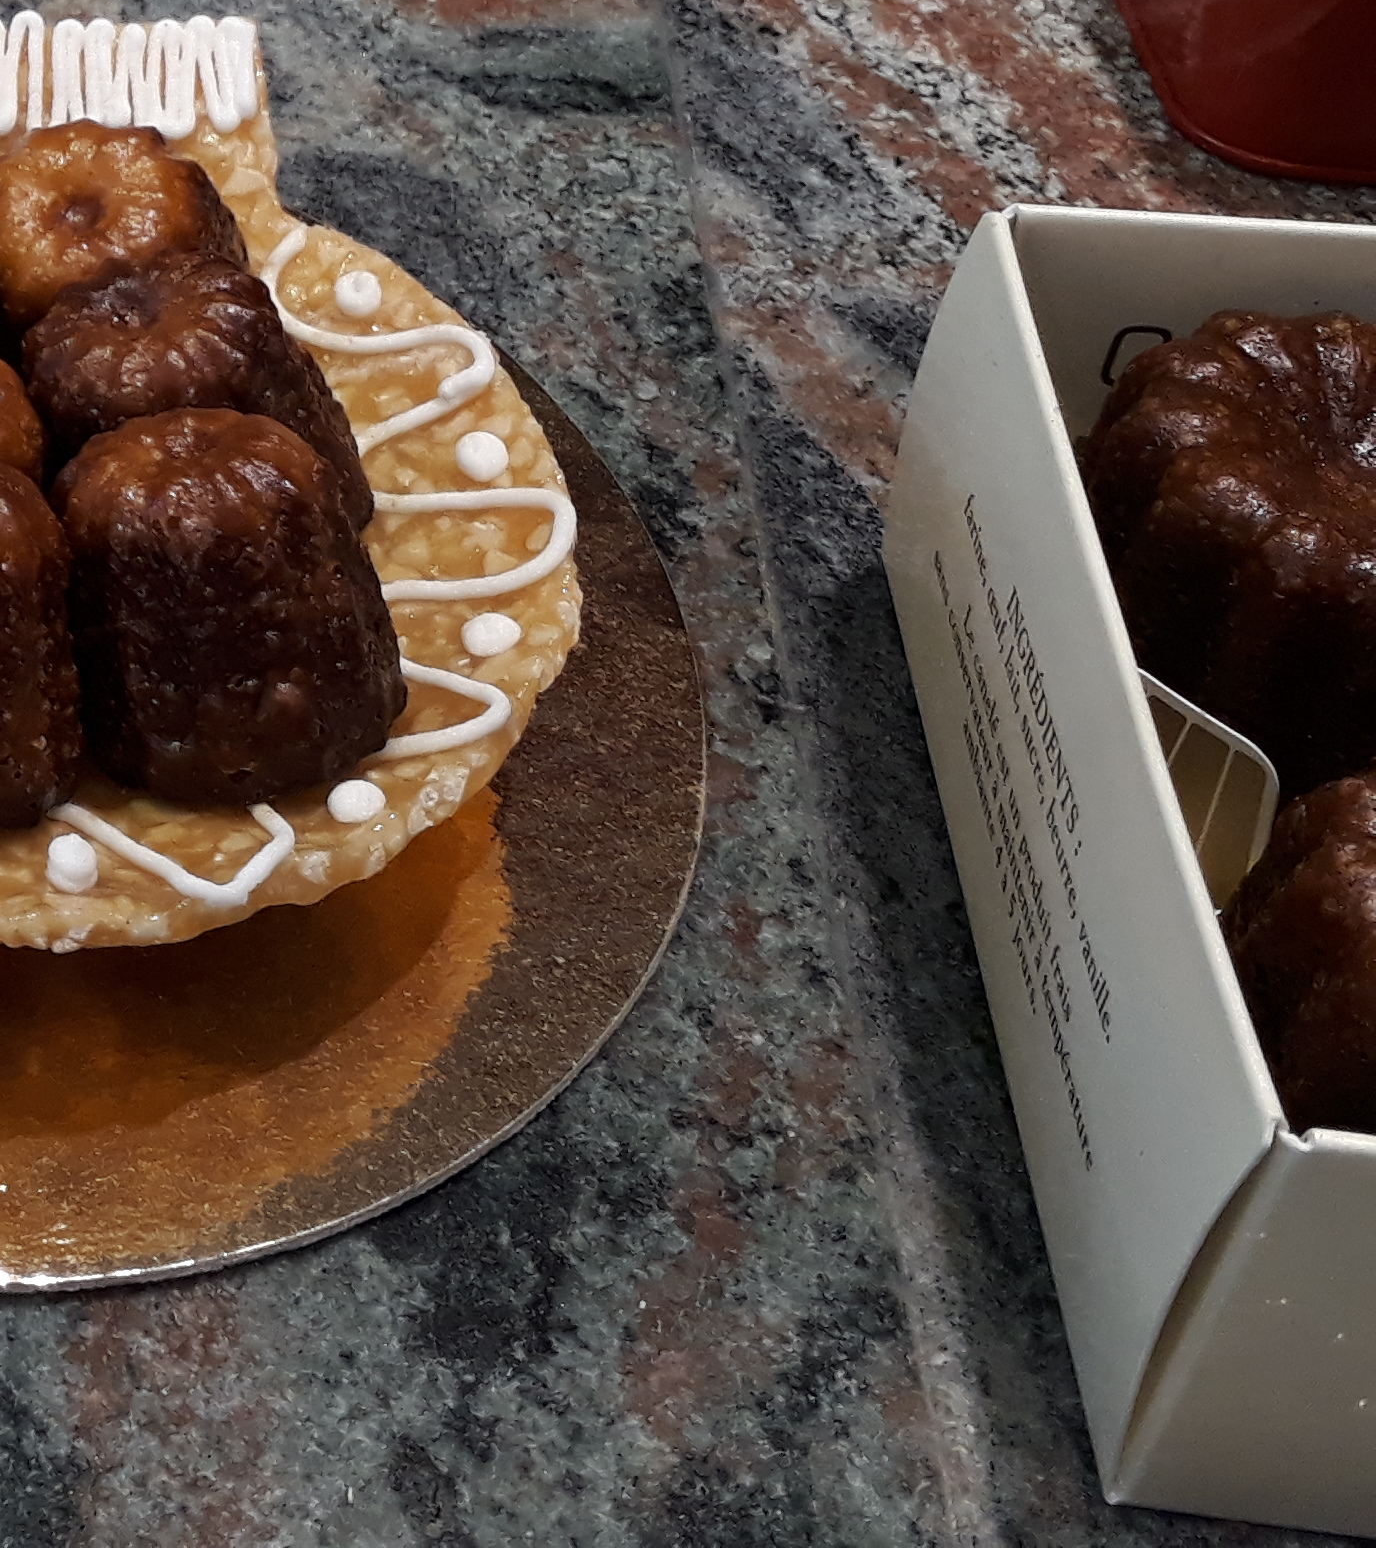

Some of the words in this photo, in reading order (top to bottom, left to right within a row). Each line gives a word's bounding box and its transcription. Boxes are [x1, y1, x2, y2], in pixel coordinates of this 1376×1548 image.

[987, 586, 1008, 653] œuf,
[1021, 714, 1046, 806] sucre,
[1046, 797, 1078, 920] beurre,
[1079, 919, 1112, 1045] vanille.
[1007, 584, 1080, 834] INGRÉDIENTS
[999, 801, 1036, 944] maintenir
[1041, 974, 1093, 1172] température
[1008, 787, 1021, 830] un
[1018, 833, 1052, 946] produit
[1050, 944, 1071, 1023] frais
